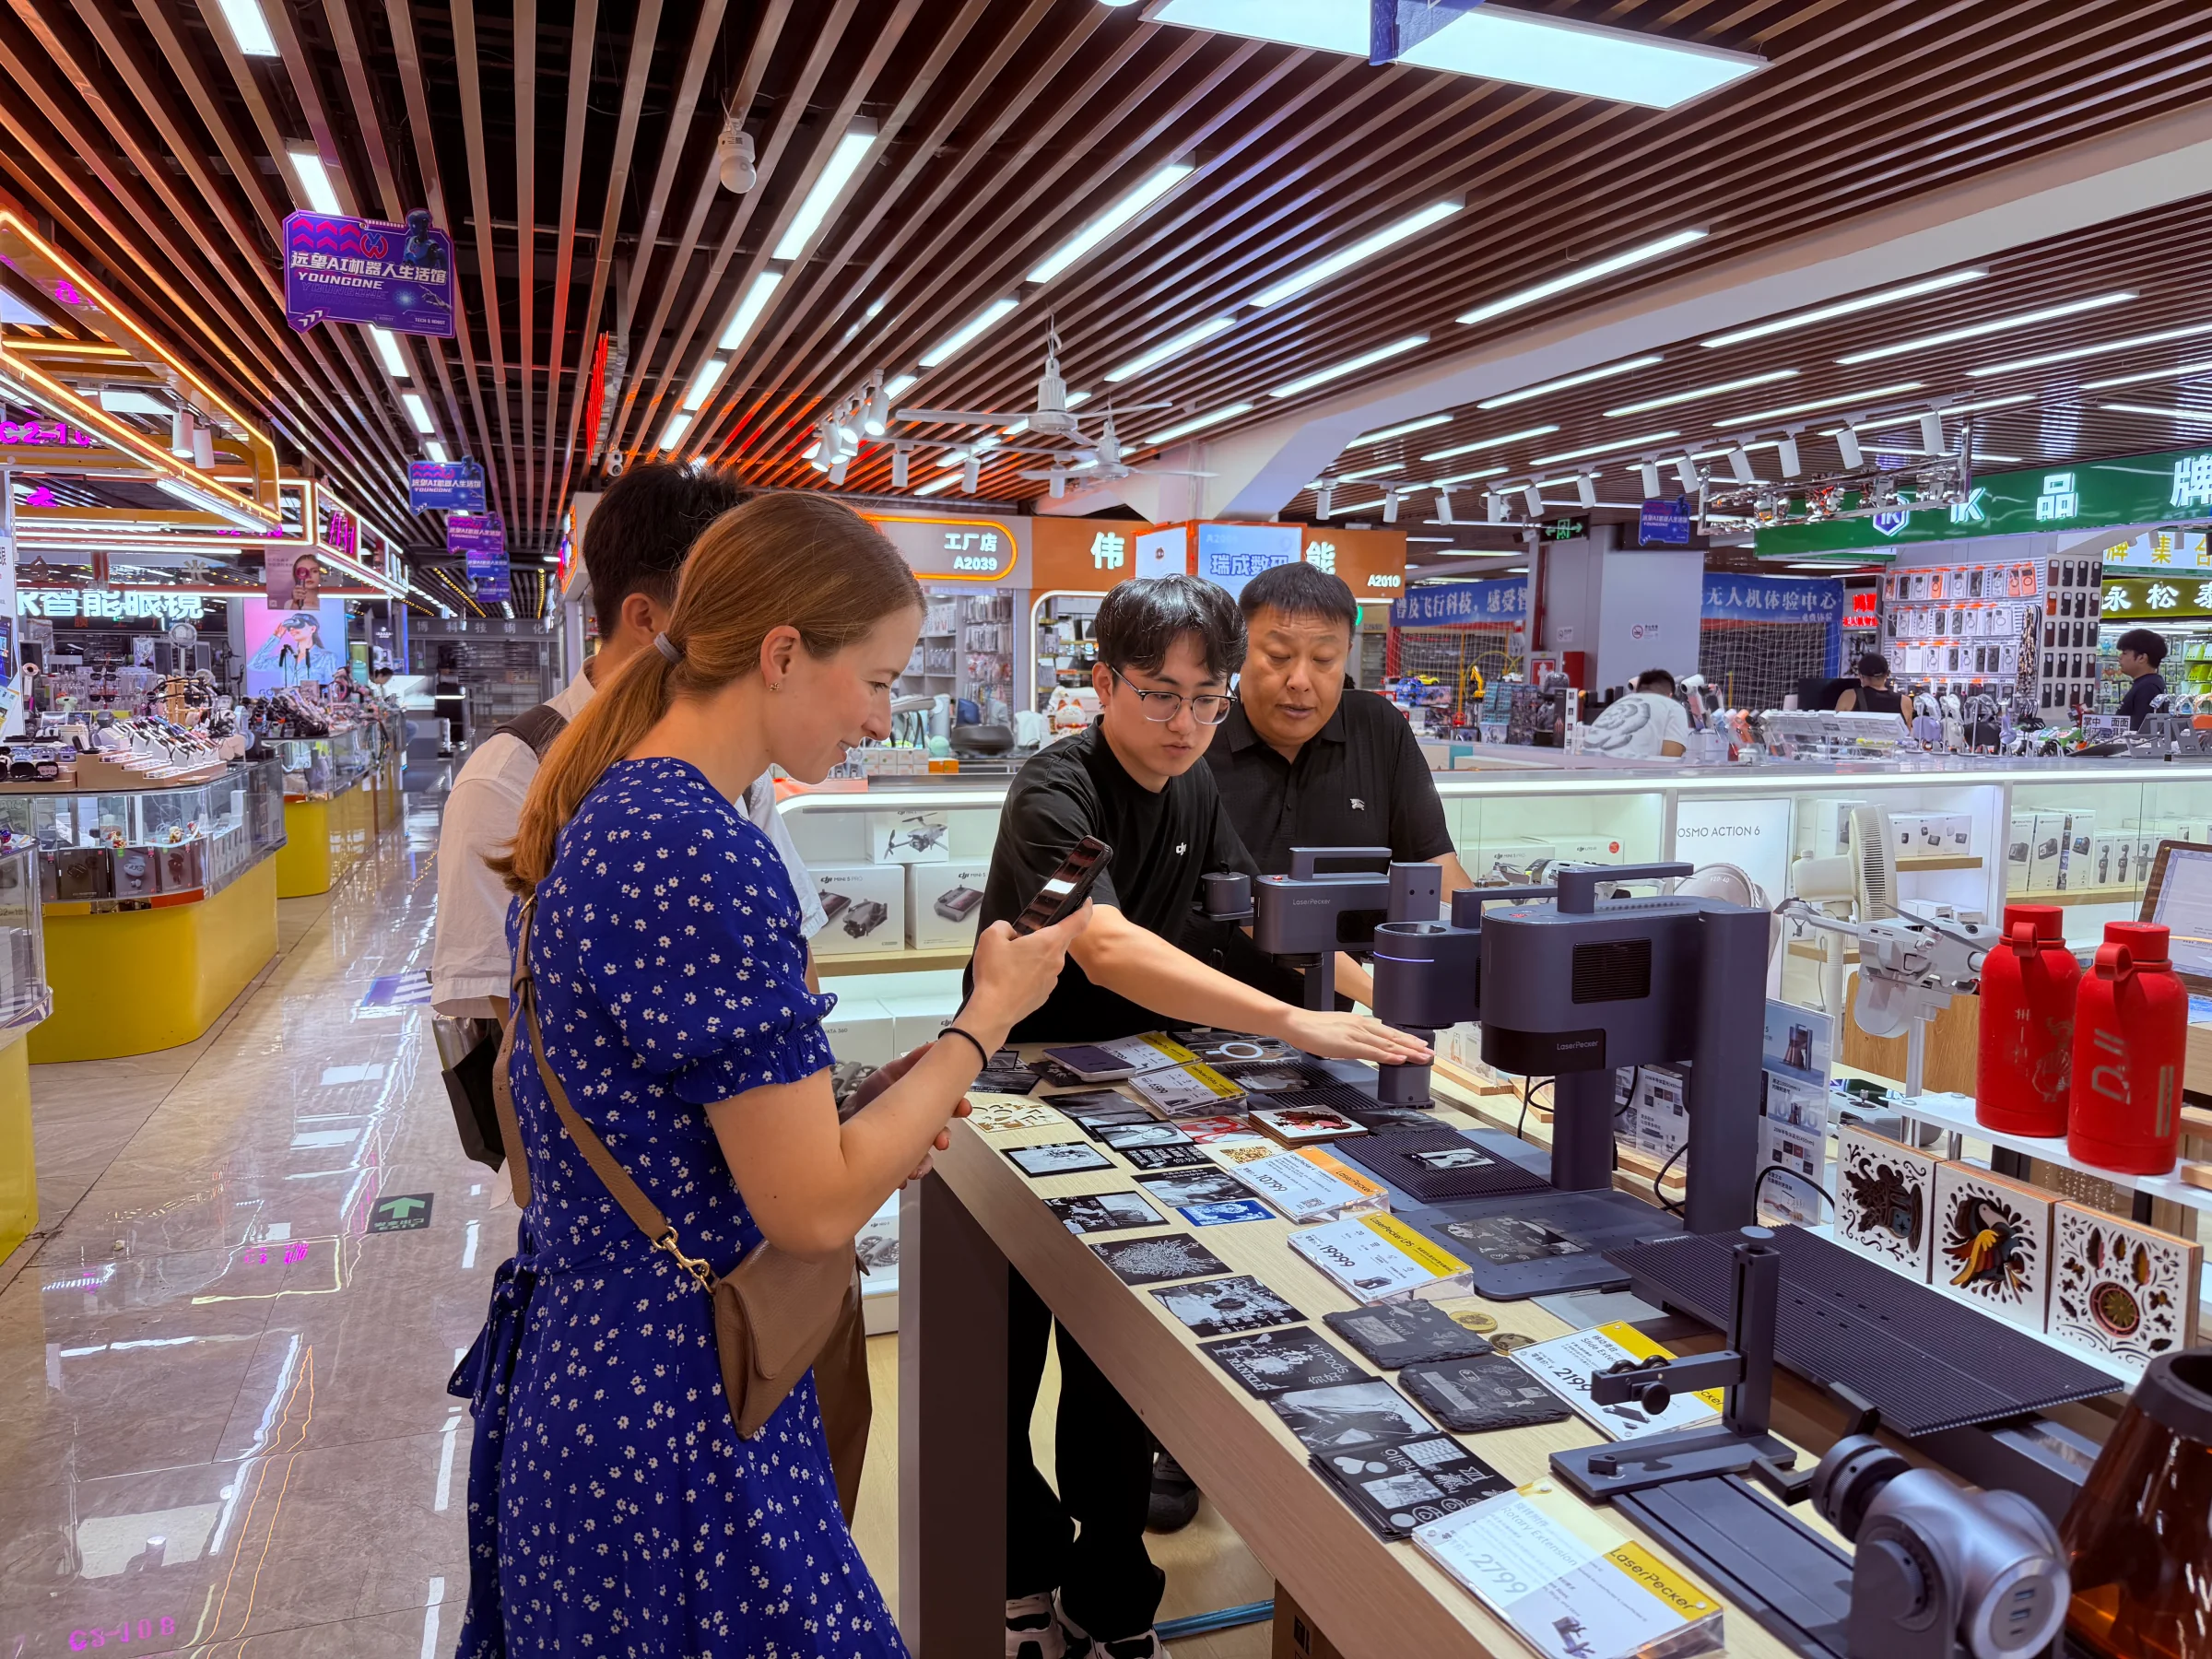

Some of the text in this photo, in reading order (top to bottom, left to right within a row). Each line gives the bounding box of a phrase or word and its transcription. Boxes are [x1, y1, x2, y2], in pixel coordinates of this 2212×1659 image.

[290, 251, 447, 285] 远望AI机器人生活馆
[298, 272, 384, 289] YOUNGONE
[944, 532, 998, 552] 工厂店
[1089, 532, 1125, 570] 伟
[953, 556, 998, 571] A2039
[1367, 574, 1401, 588] A2010
[1677, 826, 1760, 838] OSMO ACTION 6
[1292, 898, 1331, 906] LaserPecker
[1556, 1040, 1600, 1051] LaserPecker
[1255, 1173, 1288, 1193] 10799
[1335, 1170, 1373, 1193] LaserPecker
[1370, 1217, 1405, 1241] LaserPecker
[1319, 1244, 1356, 1267] 19999
[1580, 1337, 1599, 1352] Slide
[1302, 1343, 1349, 1374] AirPods
[1552, 1367, 1593, 1392] 2199
[1384, 1447, 1422, 1475] hello
[1500, 1506, 1578, 1566] Rotary Extension
[1469, 1553, 1530, 1594] 2799
[1609, 1547, 1696, 1610] LaserPecker
